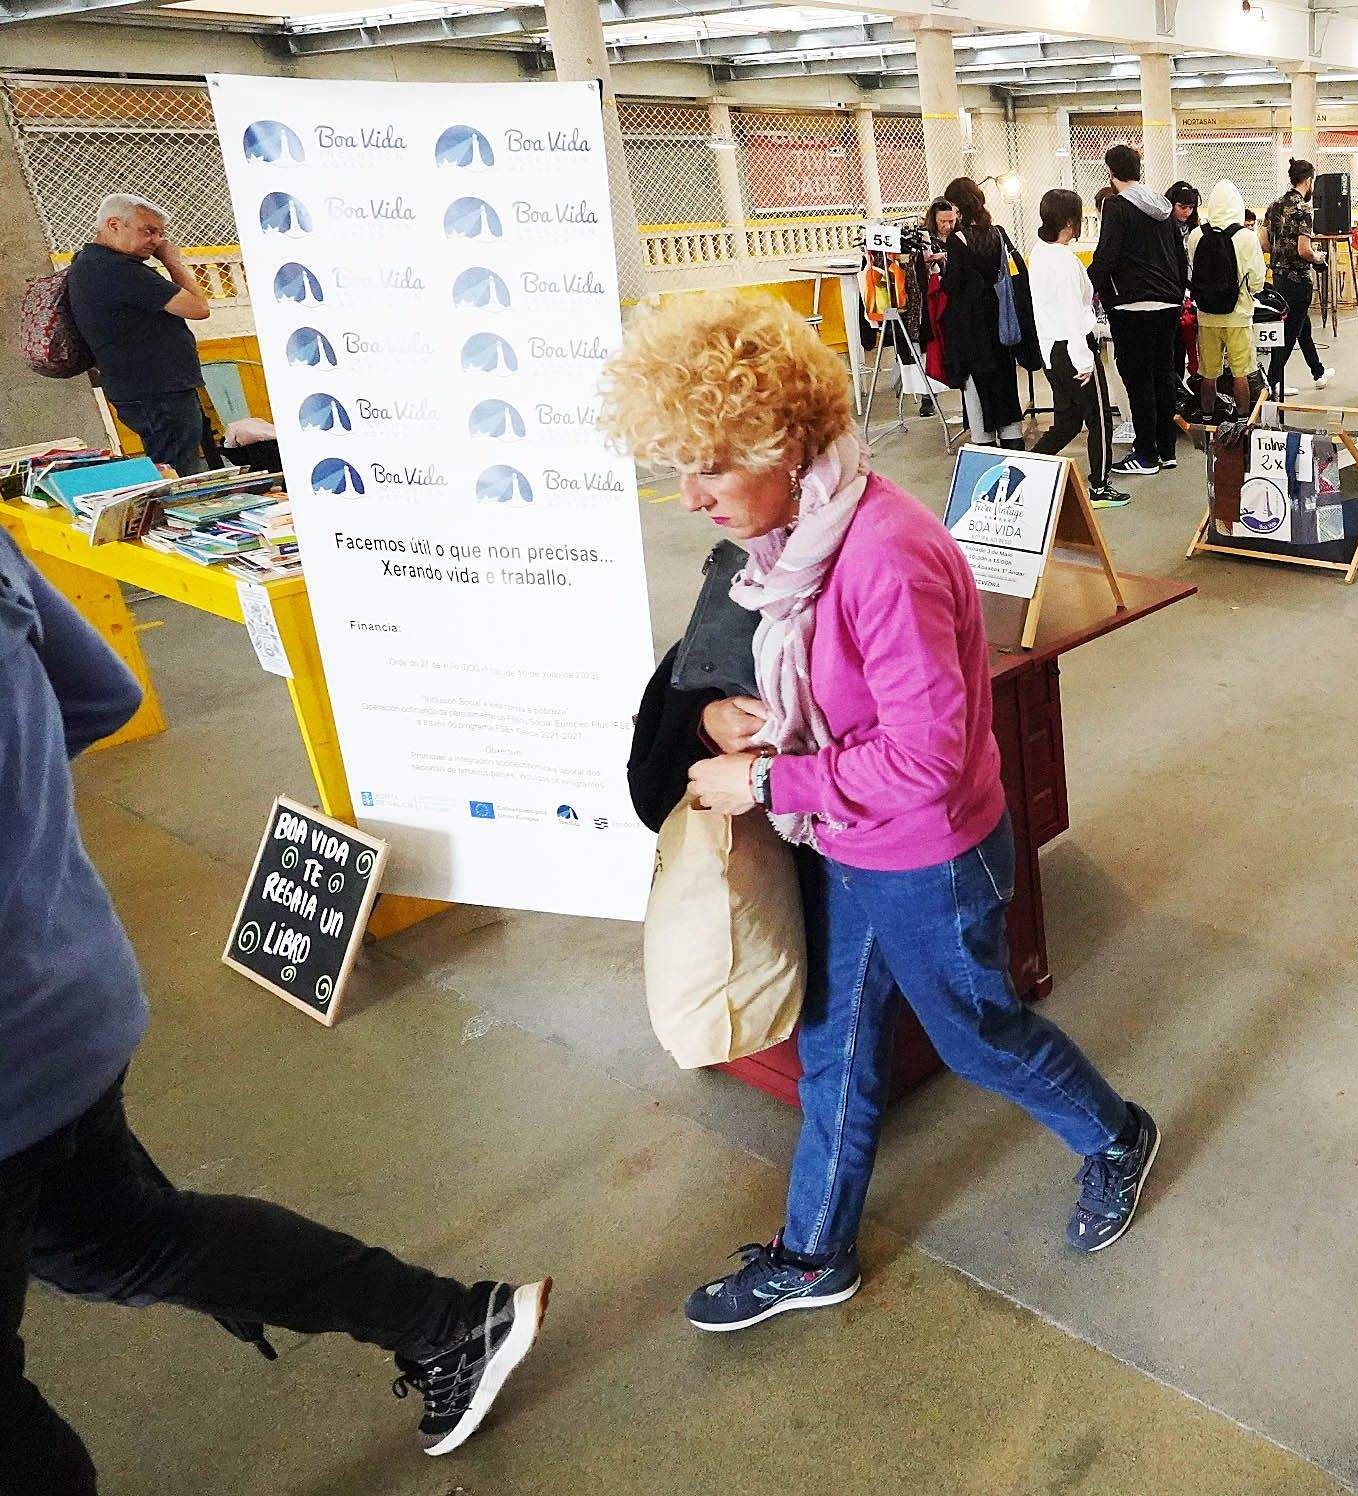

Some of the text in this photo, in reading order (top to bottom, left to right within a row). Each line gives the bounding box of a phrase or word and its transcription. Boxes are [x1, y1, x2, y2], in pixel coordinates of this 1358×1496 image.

[314, 125, 408, 150] Boa Vida
[504, 128, 592, 153] Boa Vida
[370, 196, 417, 220] Vida
[512, 200, 600, 224] Boa Vida
[872, 233, 894, 249] 5€
[520, 271, 606, 294] Boa Vida
[1258, 330, 1278, 342] 5€
[528, 337, 567, 359] Boa
[356, 398, 392, 420] Boa
[535, 403, 574, 425] Boa
[370, 463, 449, 486] Boa Vida
[542, 469, 625, 492] Boa Vida
[968, 519, 991, 533] BOA
[995, 523, 1022, 539] VIDA
[334, 532, 615, 564] Facemos útil o que non precisas...
[381, 559, 573, 587] Xerando vida e traballo.
[349, 620, 403, 634] Financia:
[274, 812, 350, 867] BOA VIDA
[302, 858, 324, 888] TE
